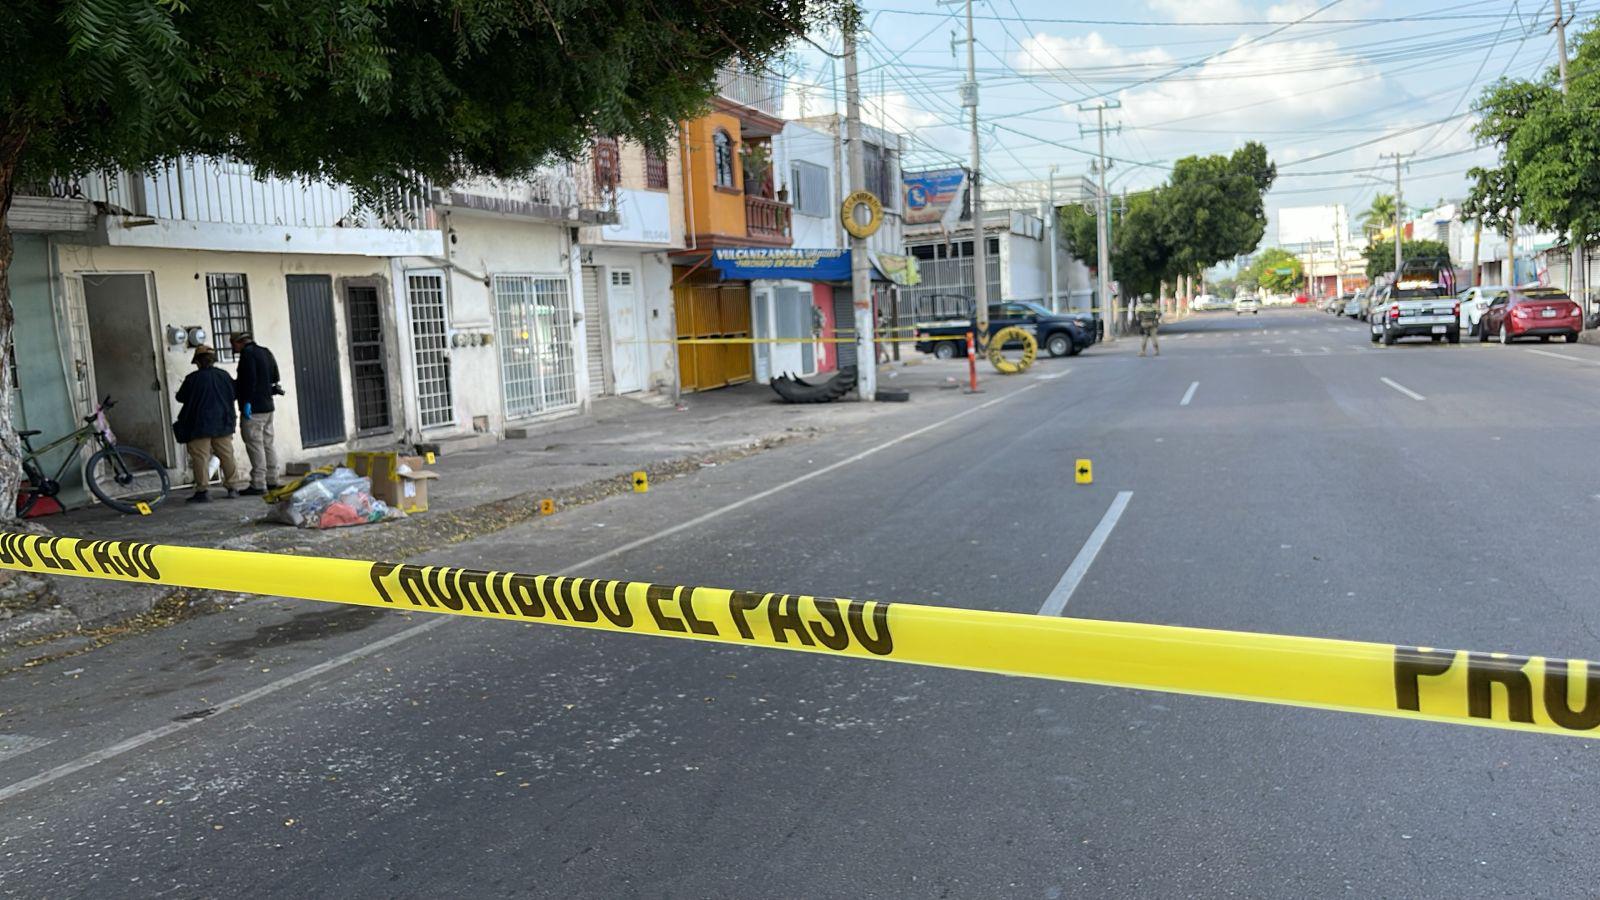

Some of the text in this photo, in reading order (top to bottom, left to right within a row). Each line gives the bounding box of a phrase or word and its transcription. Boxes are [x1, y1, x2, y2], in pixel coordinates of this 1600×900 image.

[716, 249, 804, 260] VULCANIZADORA
[34, 536, 77, 570] EL
[75, 539, 160, 580] PASO
[370, 562, 893, 656] PROHIBIDO EL PASO
